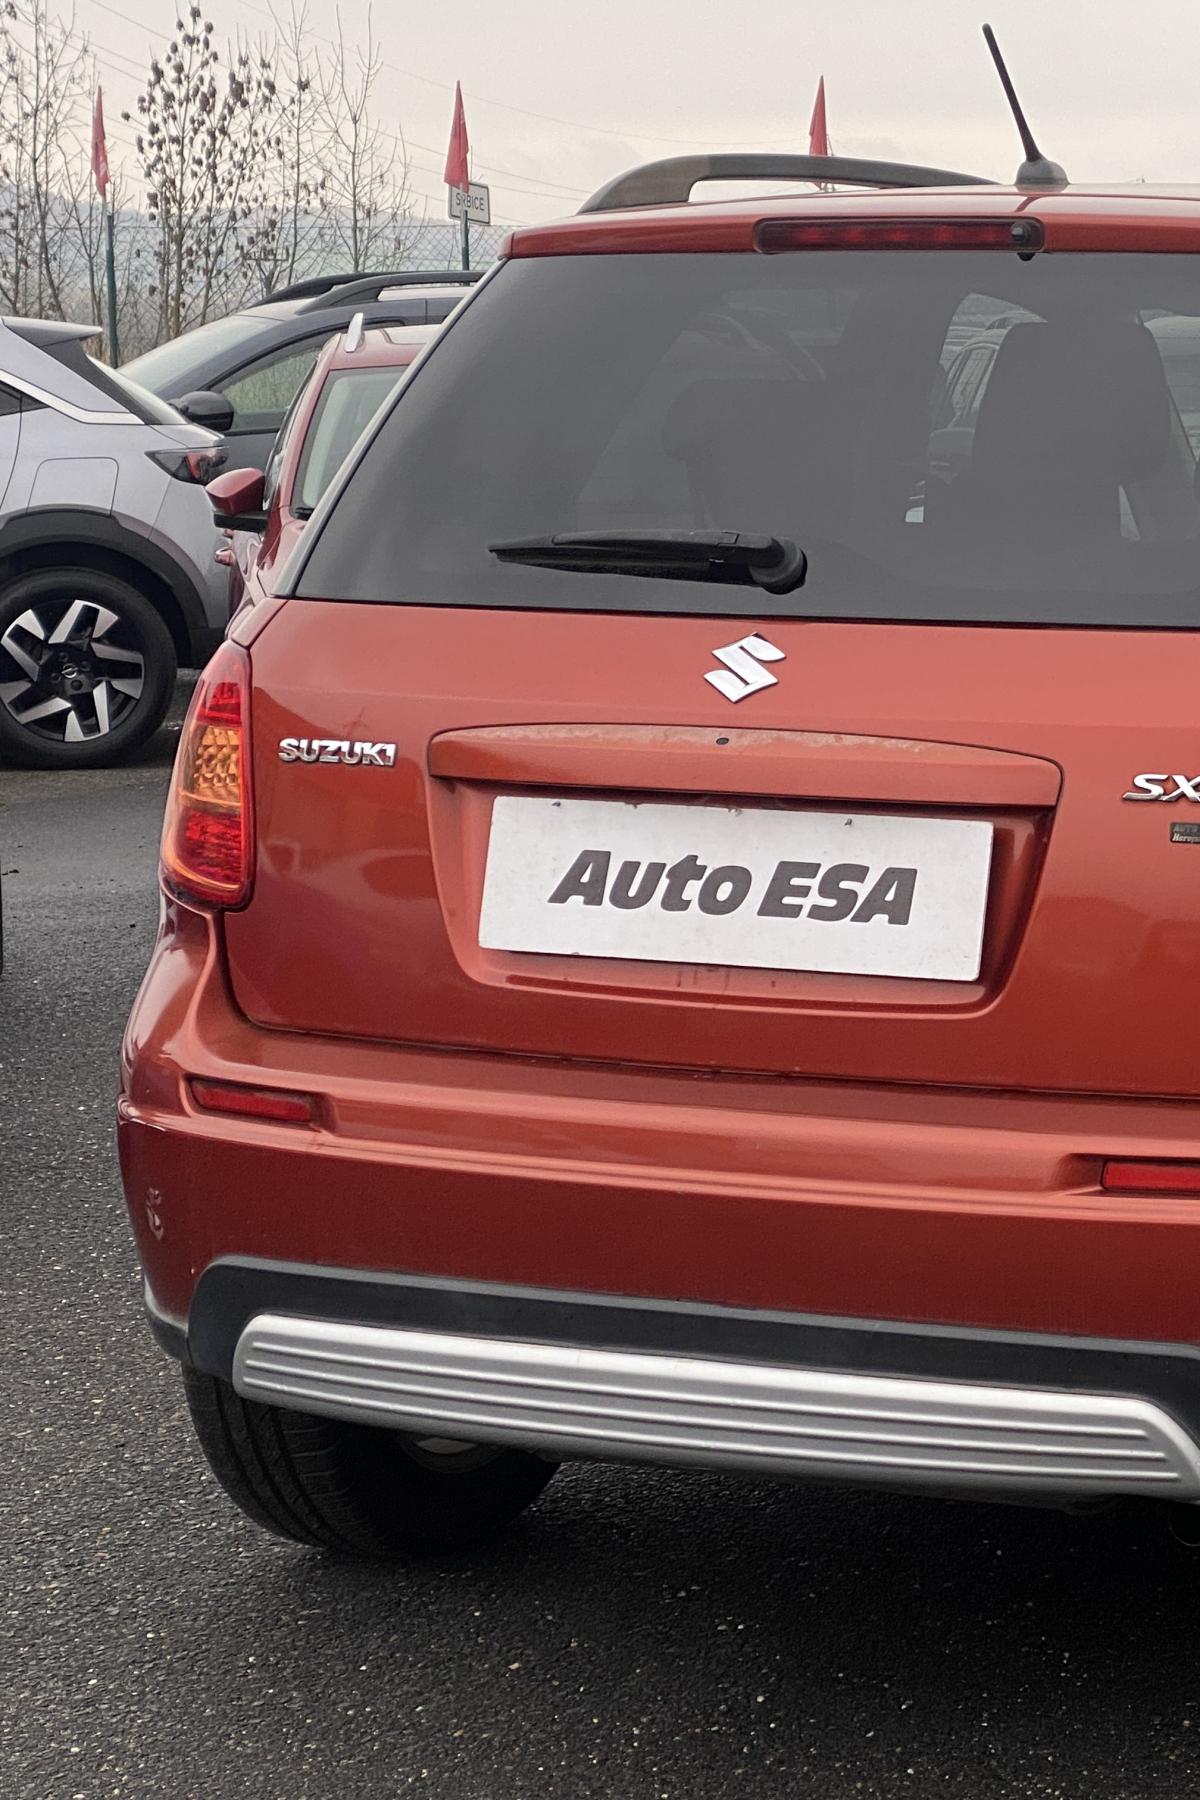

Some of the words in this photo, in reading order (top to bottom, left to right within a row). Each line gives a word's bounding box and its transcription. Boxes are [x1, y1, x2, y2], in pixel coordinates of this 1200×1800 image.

[278, 738, 397, 767] SUZUKI
[547, 849, 752, 915] Auto
[757, 860, 918, 925] ESA
